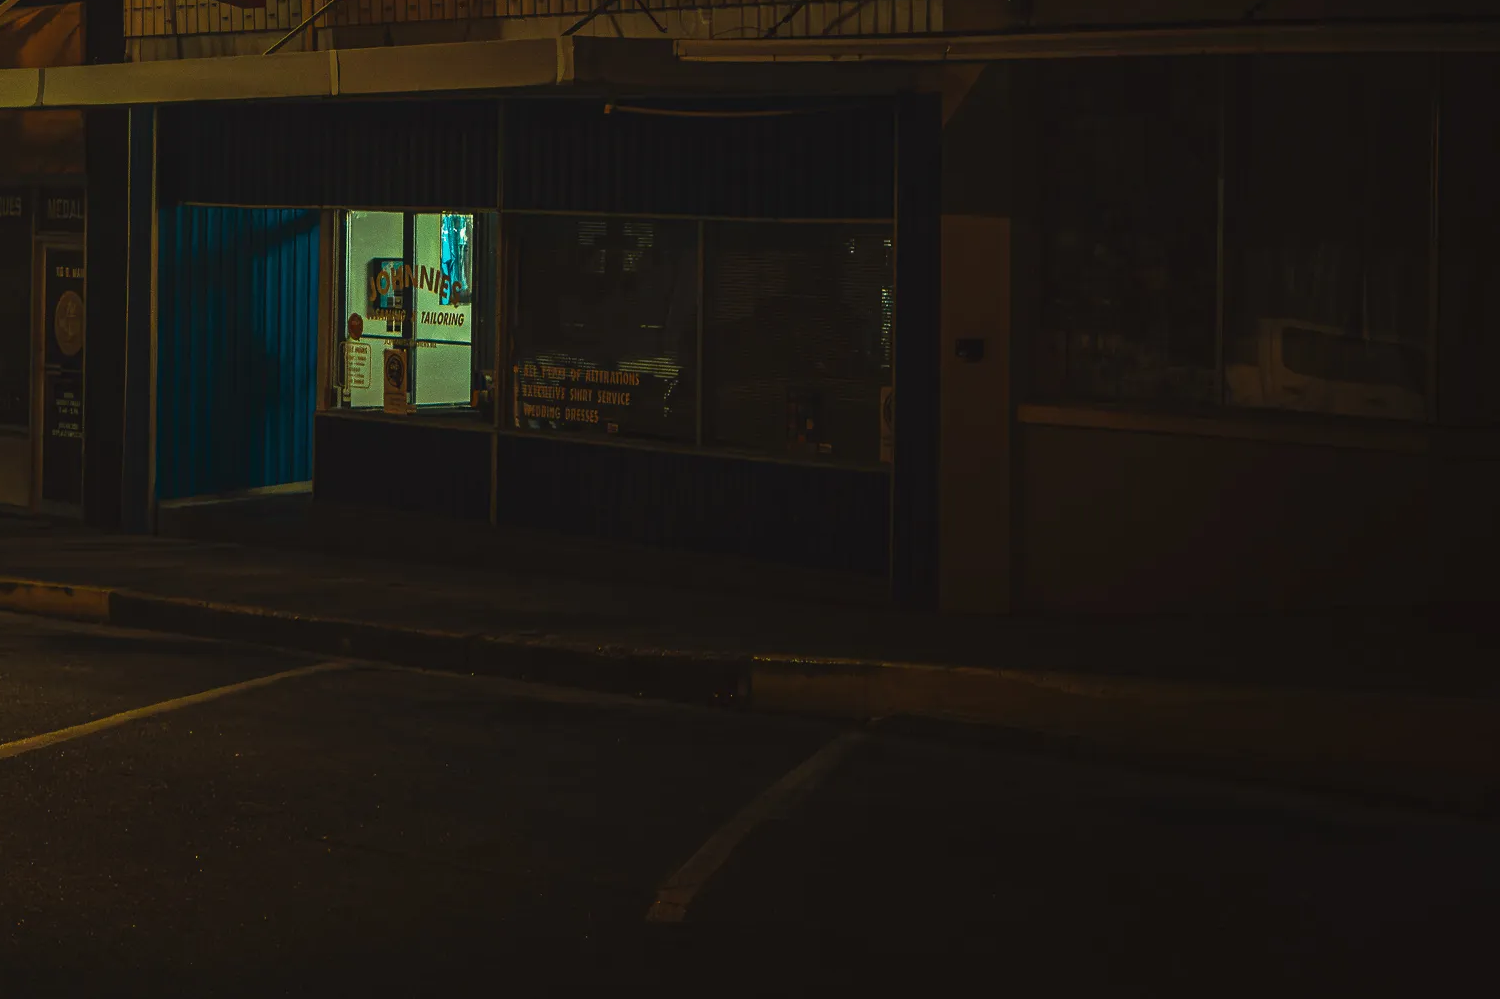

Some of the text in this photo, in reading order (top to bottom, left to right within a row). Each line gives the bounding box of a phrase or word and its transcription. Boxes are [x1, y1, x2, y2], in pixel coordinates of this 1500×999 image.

[368, 263, 463, 308] JOHNNIES
[420, 311, 465, 327] TAILORING
[585, 369, 640, 386] ALTERATIONS
[570, 387, 593, 402] SHIRT
[597, 389, 631, 406] SERVICE
[523, 402, 599, 424] WEDDING DRESSES
